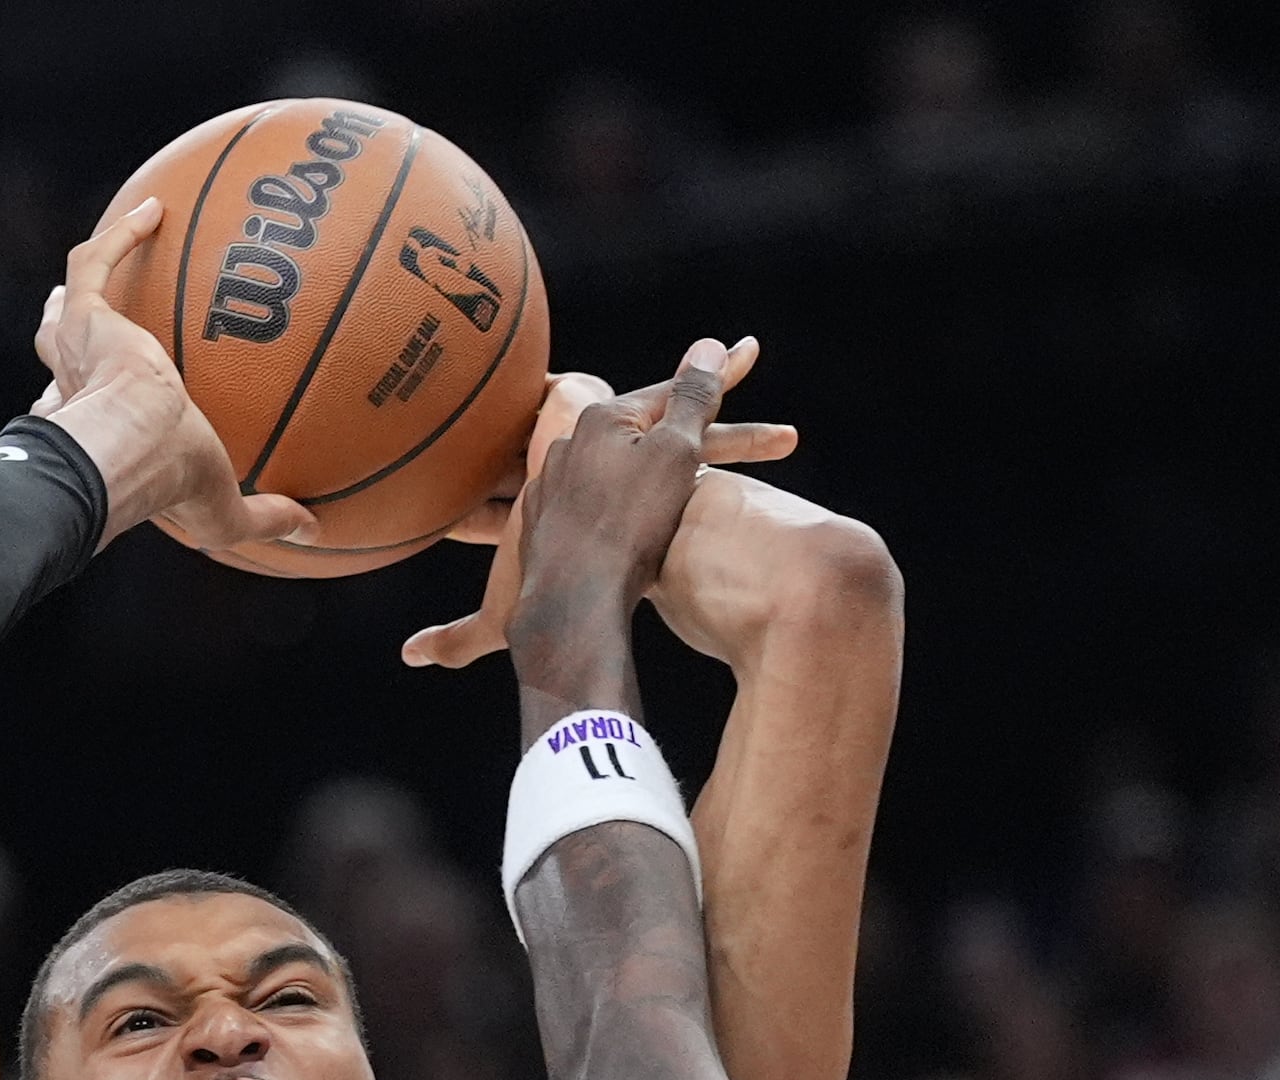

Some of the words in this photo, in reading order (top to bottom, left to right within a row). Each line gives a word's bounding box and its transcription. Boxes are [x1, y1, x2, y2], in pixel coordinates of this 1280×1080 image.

[202, 111, 387, 344] Wilson
[547, 717, 642, 754] TORAYA
[579, 742, 636, 780] 11
